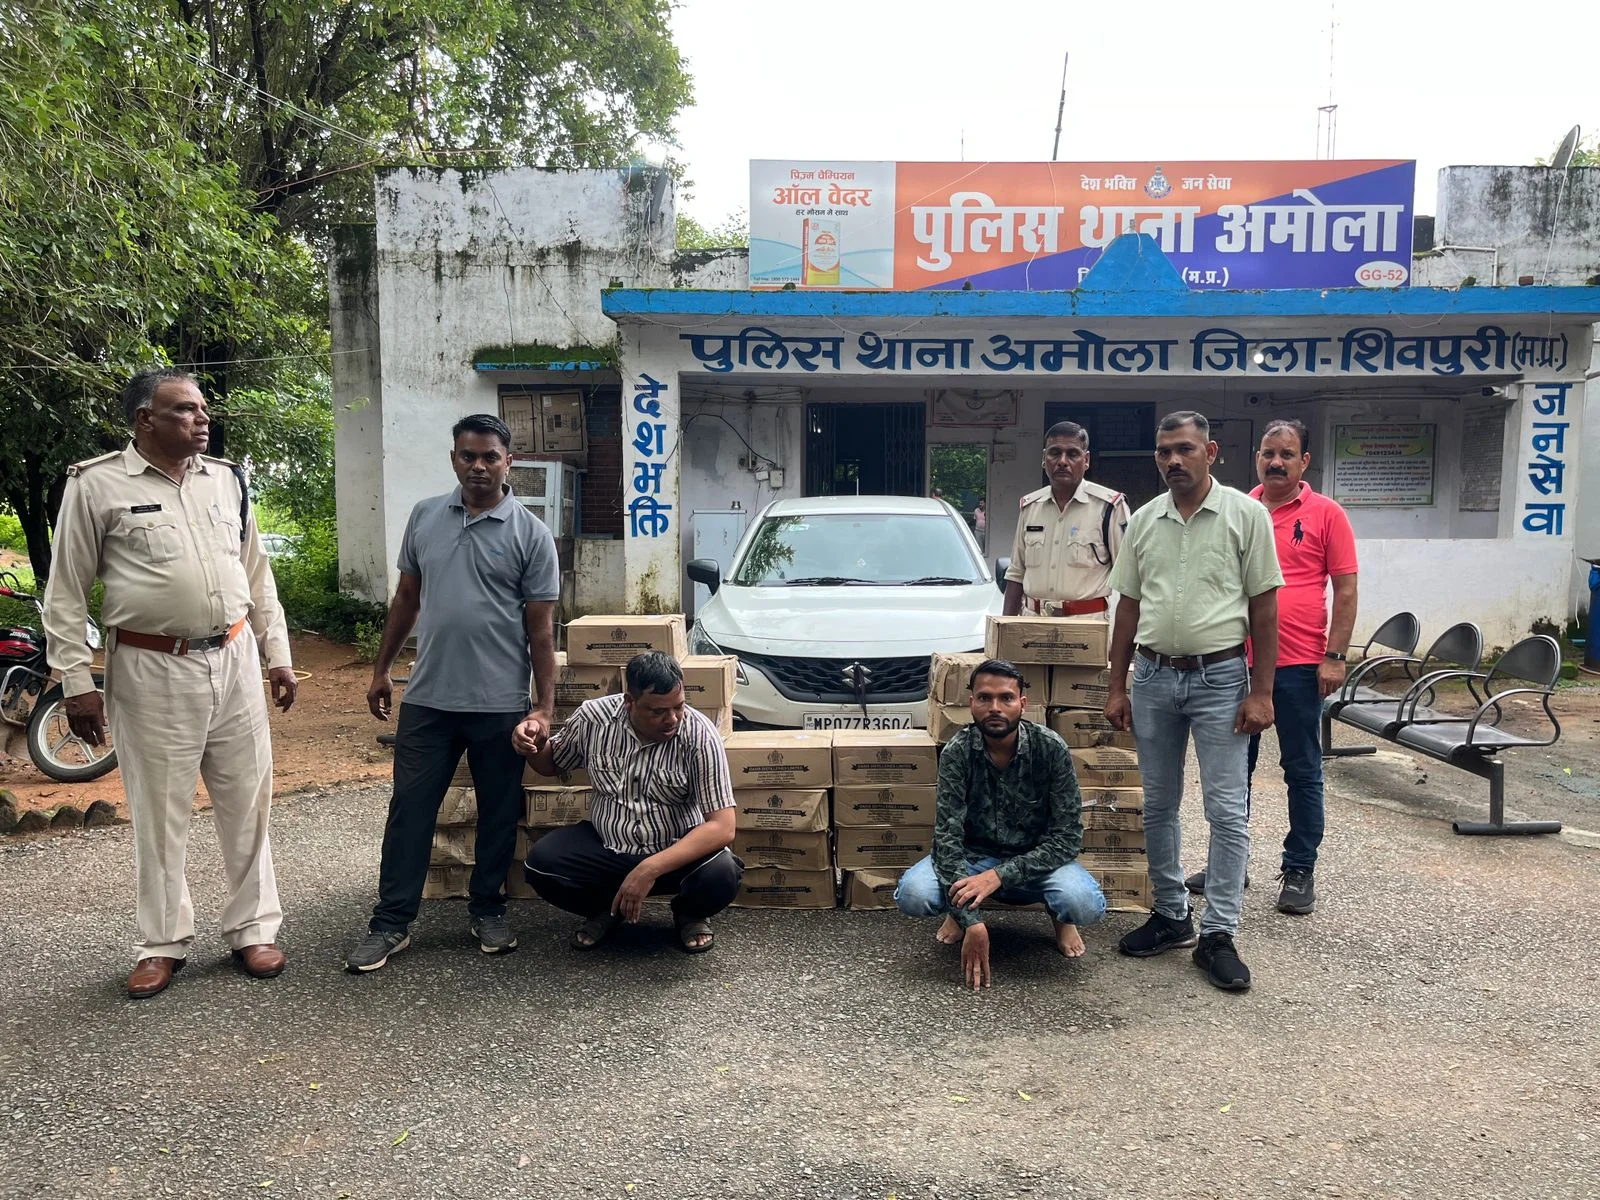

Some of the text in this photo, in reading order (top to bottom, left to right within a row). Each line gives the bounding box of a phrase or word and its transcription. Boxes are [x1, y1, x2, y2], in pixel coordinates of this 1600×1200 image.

[1080, 174, 1101, 191] देश
[1103, 174, 1137, 191] भक्ति
[1182, 176, 1204, 190] जन
[1207, 173, 1232, 190] सेवा
[772, 183, 873, 207] ऑल वेदर
[910, 191, 1065, 272] पुलिस
[1079, 204, 1201, 253] थाना
[1215, 188, 1405, 253] अमोला
[1359, 269, 1403, 282] GG-52
[679, 326, 845, 372] पुलिस
[856, 331, 974, 371] थाना
[980, 329, 1179, 372] अमोला
